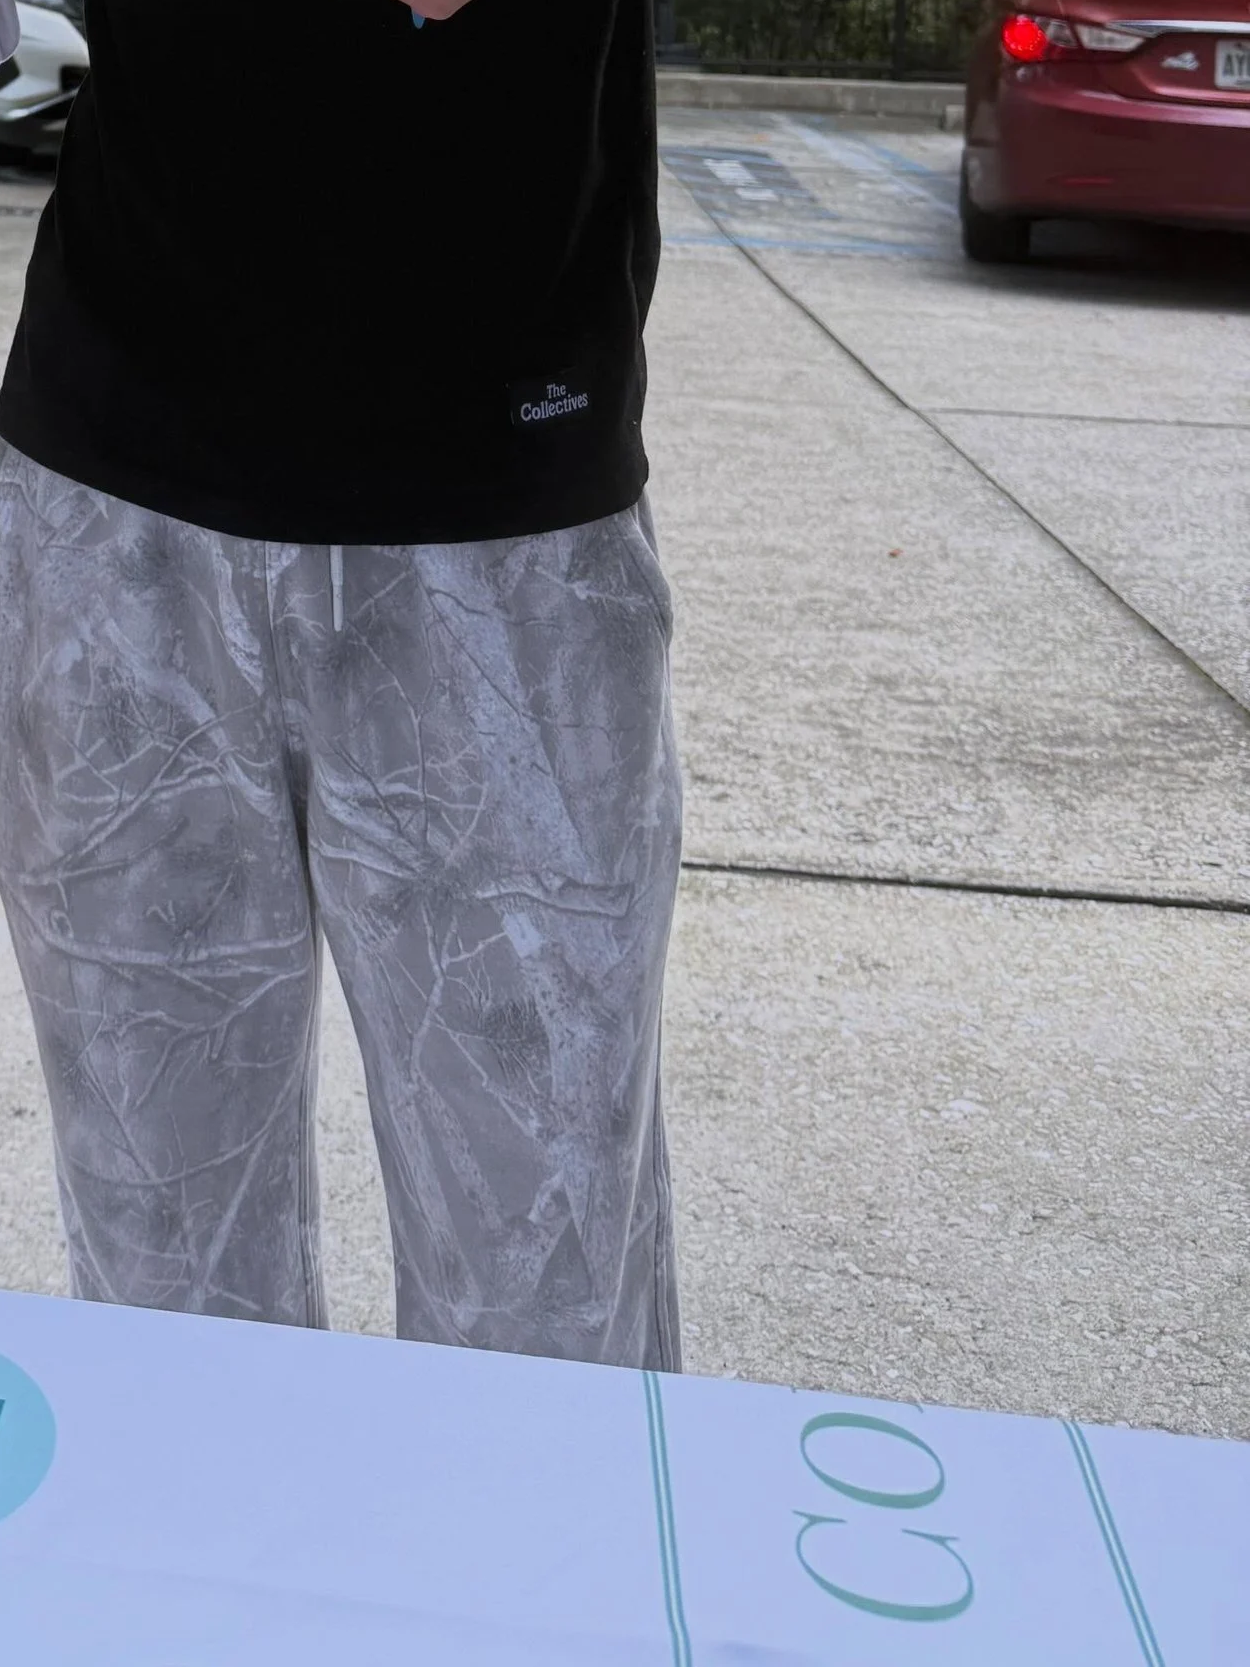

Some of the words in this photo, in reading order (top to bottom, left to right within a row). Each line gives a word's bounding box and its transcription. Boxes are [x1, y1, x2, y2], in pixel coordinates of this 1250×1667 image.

[1221, 52, 1250, 78] AY
[546, 383, 567, 399] The
[520, 393, 589, 422] Collectives
